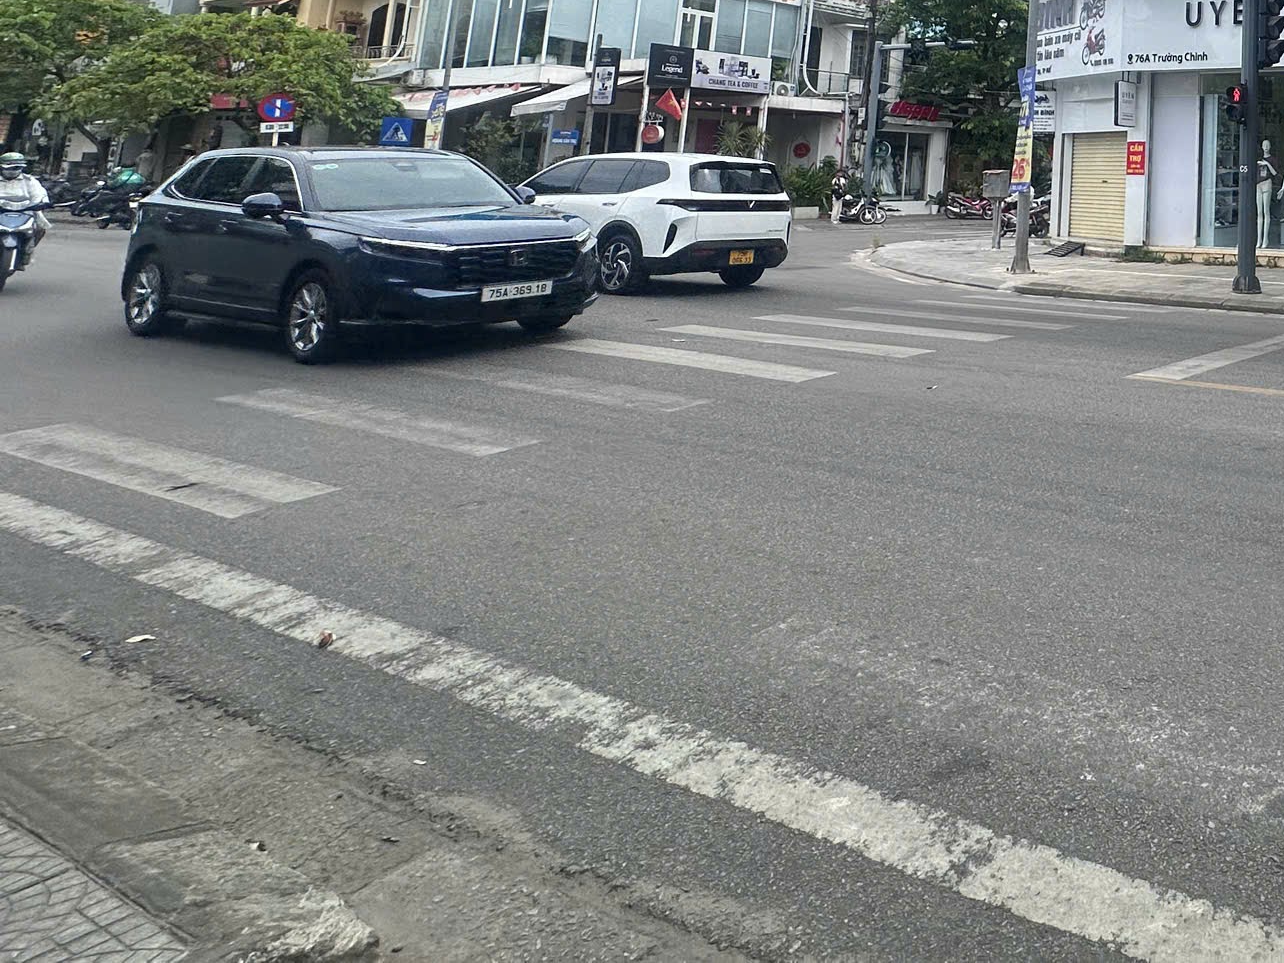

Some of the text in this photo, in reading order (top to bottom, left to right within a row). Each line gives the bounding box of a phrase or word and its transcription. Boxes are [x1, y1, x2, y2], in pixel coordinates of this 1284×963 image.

[1134, 53, 1151, 63] 76A
[1152, 52, 1183, 64] Trường
[661, 64, 684, 74] Legend
